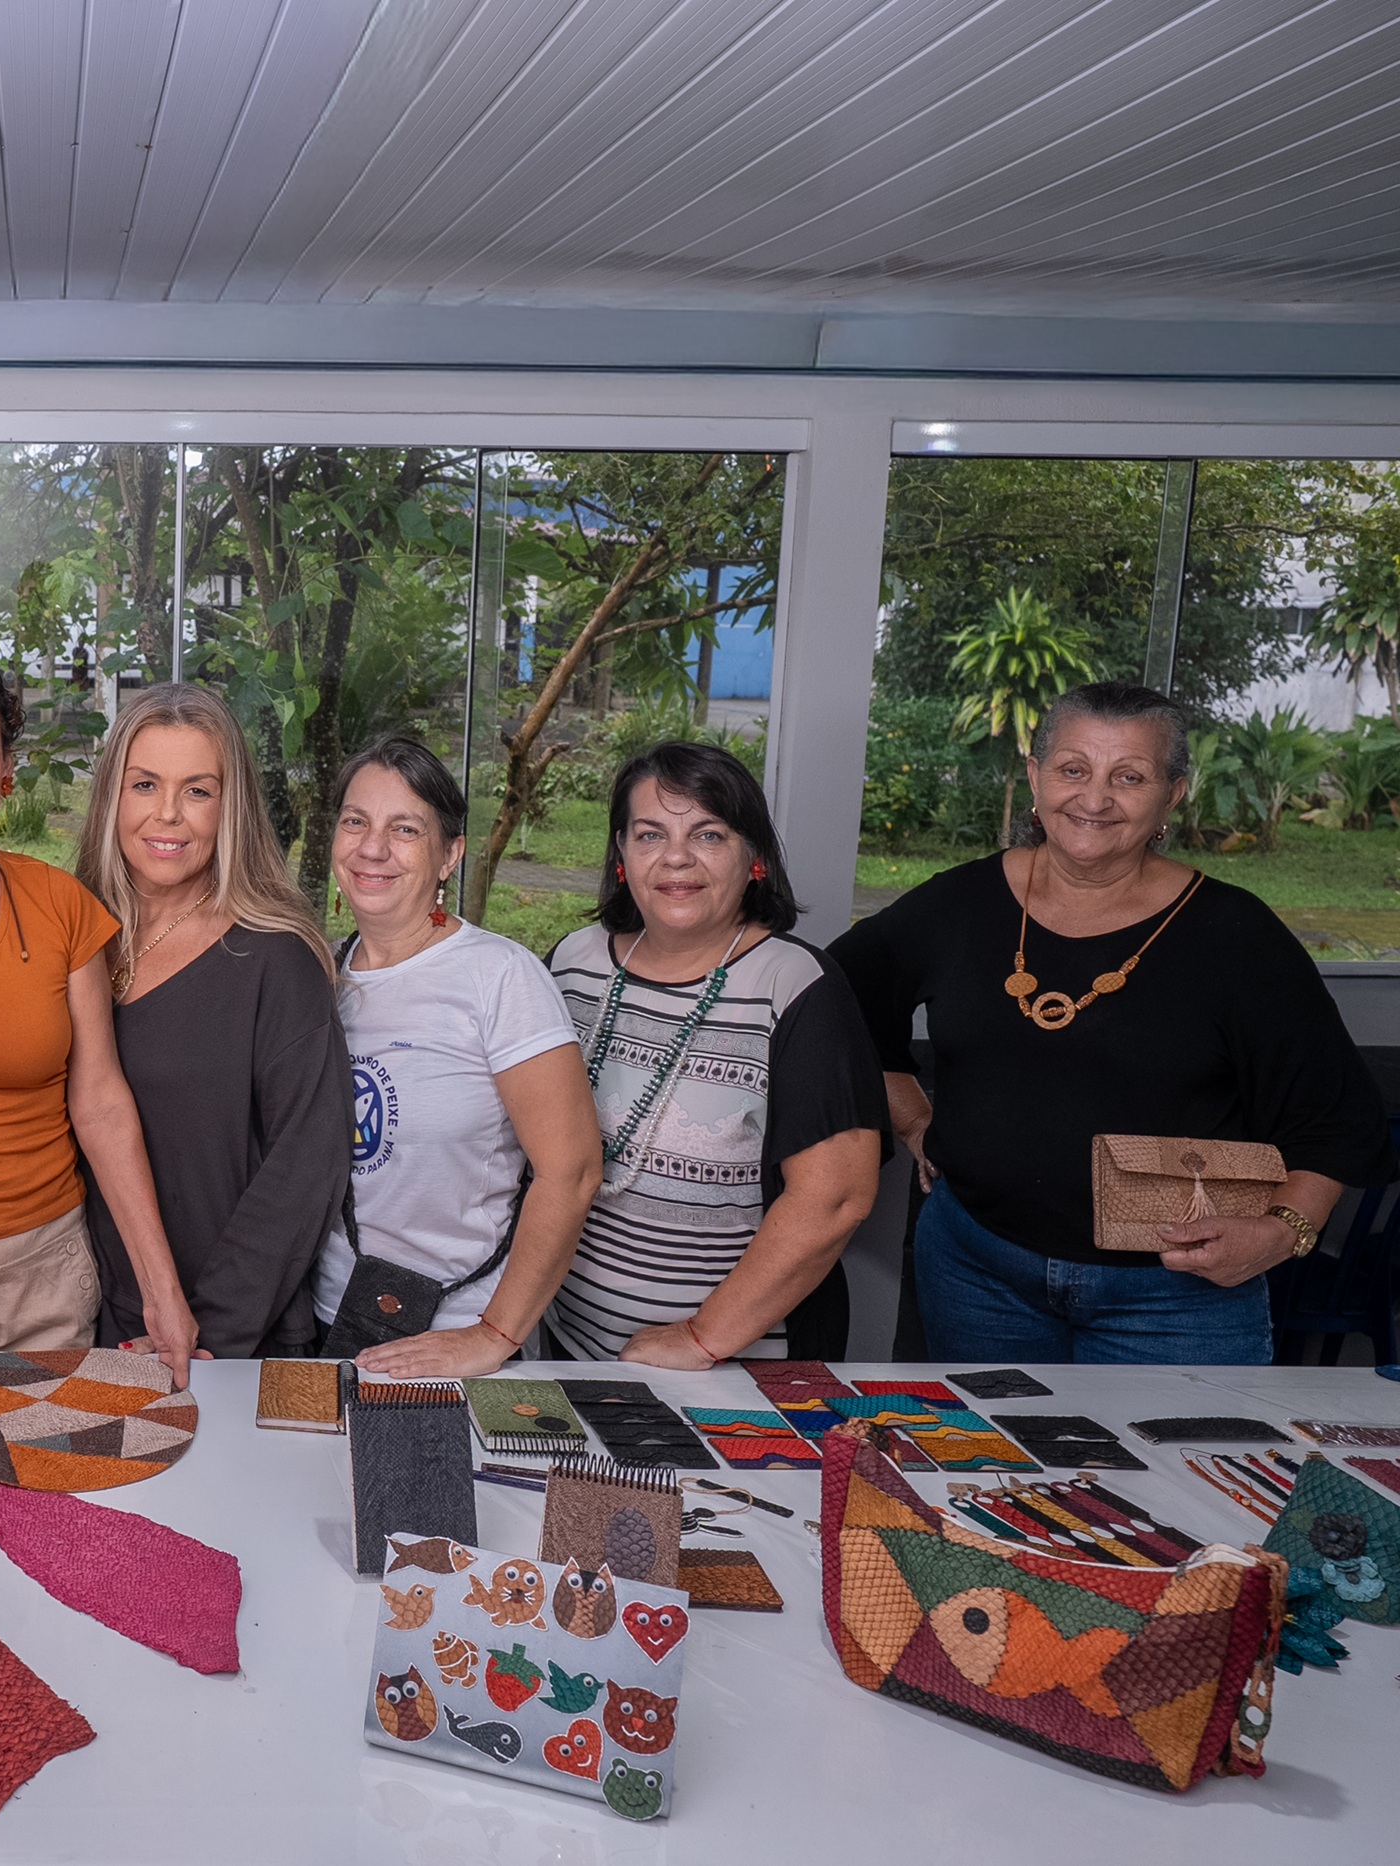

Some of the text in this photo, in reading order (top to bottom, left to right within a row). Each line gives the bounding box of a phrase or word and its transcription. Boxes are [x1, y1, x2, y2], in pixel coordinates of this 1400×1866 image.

[376, 1067, 391, 1085] DE
[385, 1086, 399, 1127] PEIXE
[352, 1139, 395, 1175] DO PARANÁ
